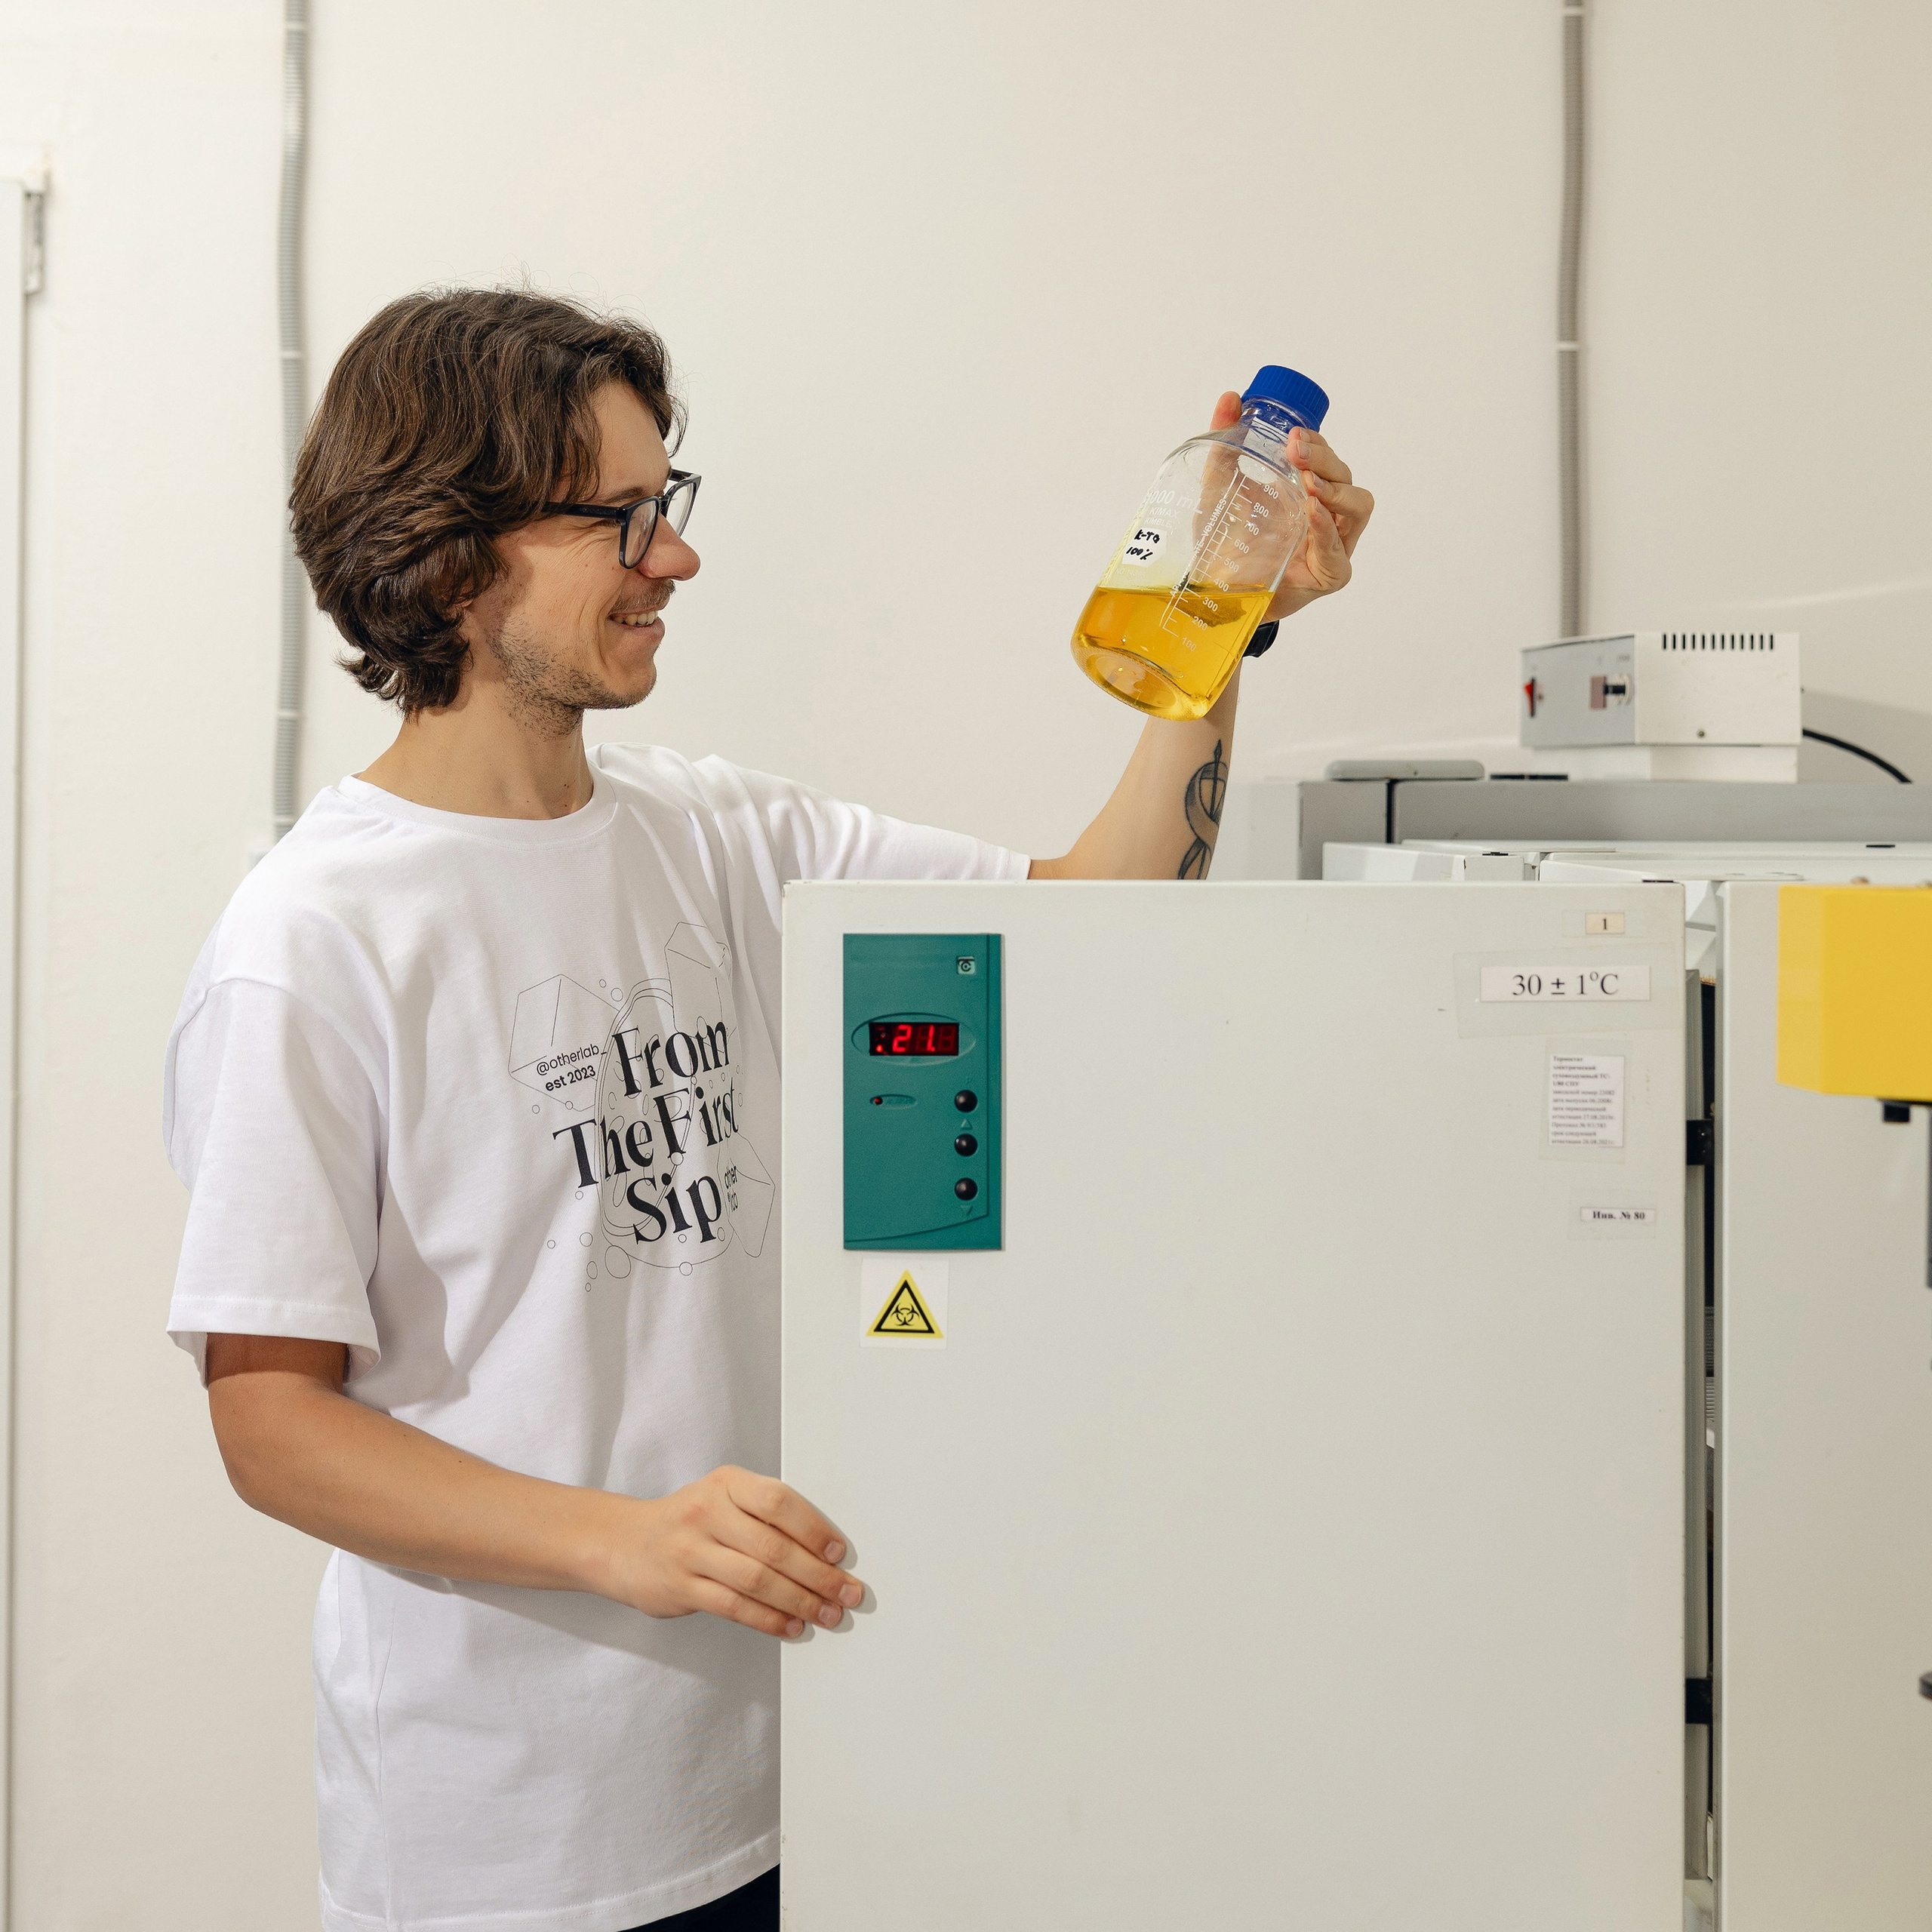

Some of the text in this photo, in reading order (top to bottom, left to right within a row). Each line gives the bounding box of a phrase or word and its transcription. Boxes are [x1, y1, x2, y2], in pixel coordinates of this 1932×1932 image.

[1263, 485, 1279, 500] 900
[1149, 506, 1181, 519] KIMAX
[1176, 495, 1203, 515] mL
[1254, 503, 1269, 518] 800
[1144, 517, 1173, 528] KIMBLE
[1201, 498, 1227, 537] VOLUMES
[1244, 520, 1260, 536] 700
[1234, 539, 1250, 554] 600
[1223, 557, 1239, 573] 500
[1213, 577, 1229, 592] 400
[1202, 597, 1218, 612] 300
[1192, 616, 1208, 631] 200
[1181, 637, 1197, 651] 100
[1602, 918, 1608, 931] 1
[1512, 974, 1542, 996] 30
[612, 1022, 730, 1097] From
[546, 1065, 595, 1091] est 2023
[552, 1077, 739, 1189] The First
[626, 1173, 721, 1245] Sip
[1634, 1211, 1645, 1220] 80
